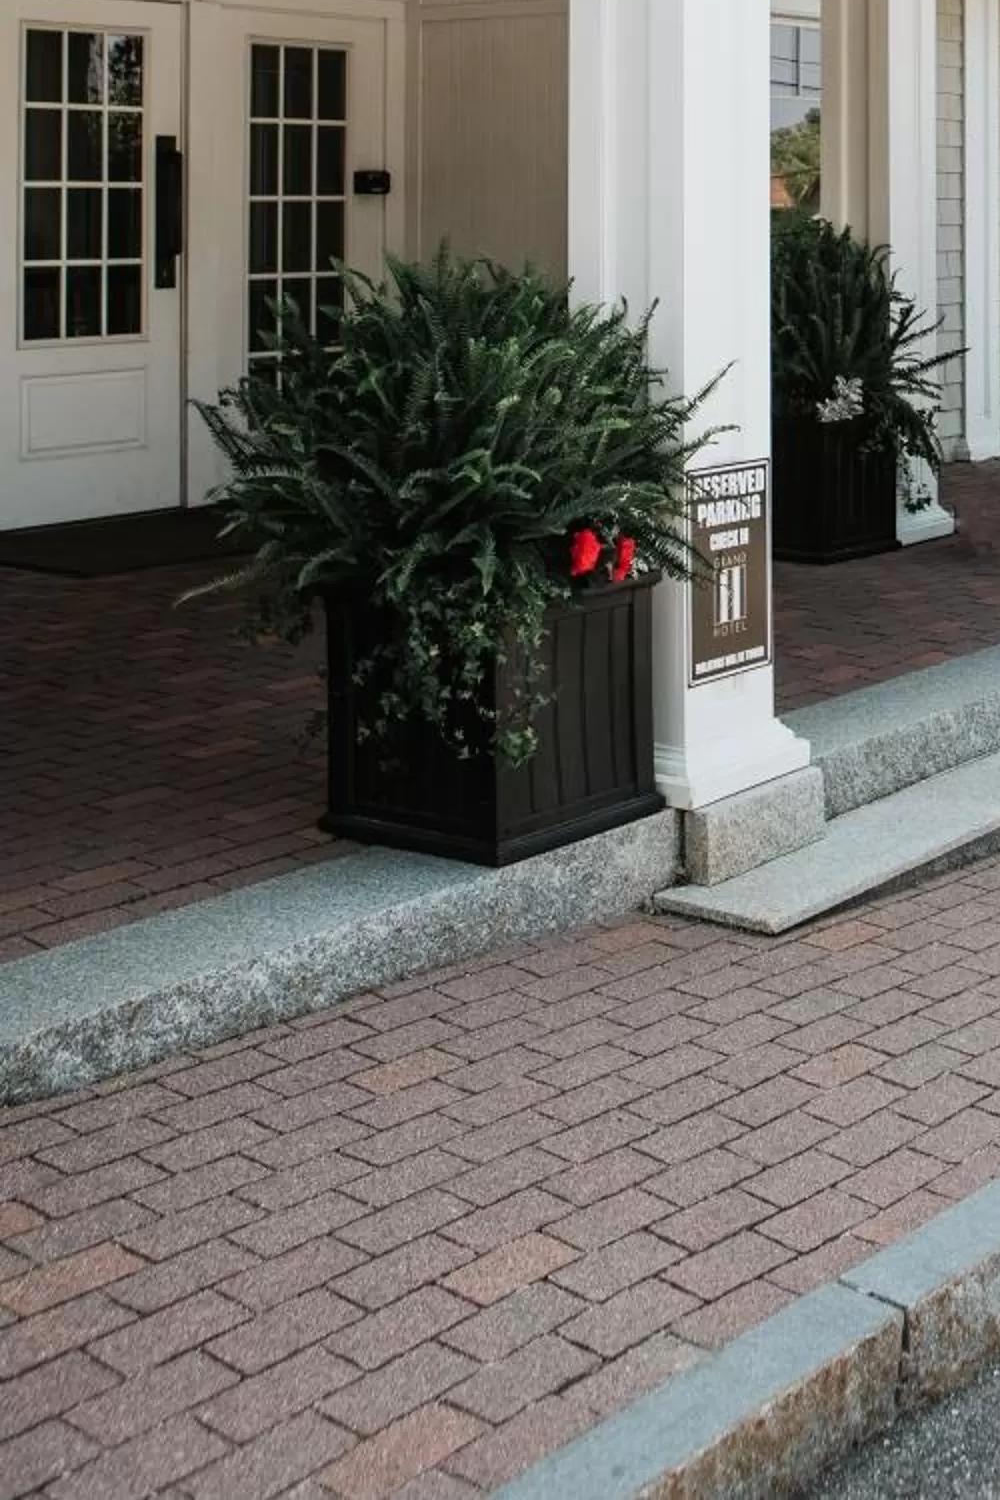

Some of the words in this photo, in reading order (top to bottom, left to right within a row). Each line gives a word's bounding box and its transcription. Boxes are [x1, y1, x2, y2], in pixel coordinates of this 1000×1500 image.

[692, 467, 765, 501] RESERVED
[697, 493, 761, 528] PARKING
[713, 622, 749, 638] HOTEL
